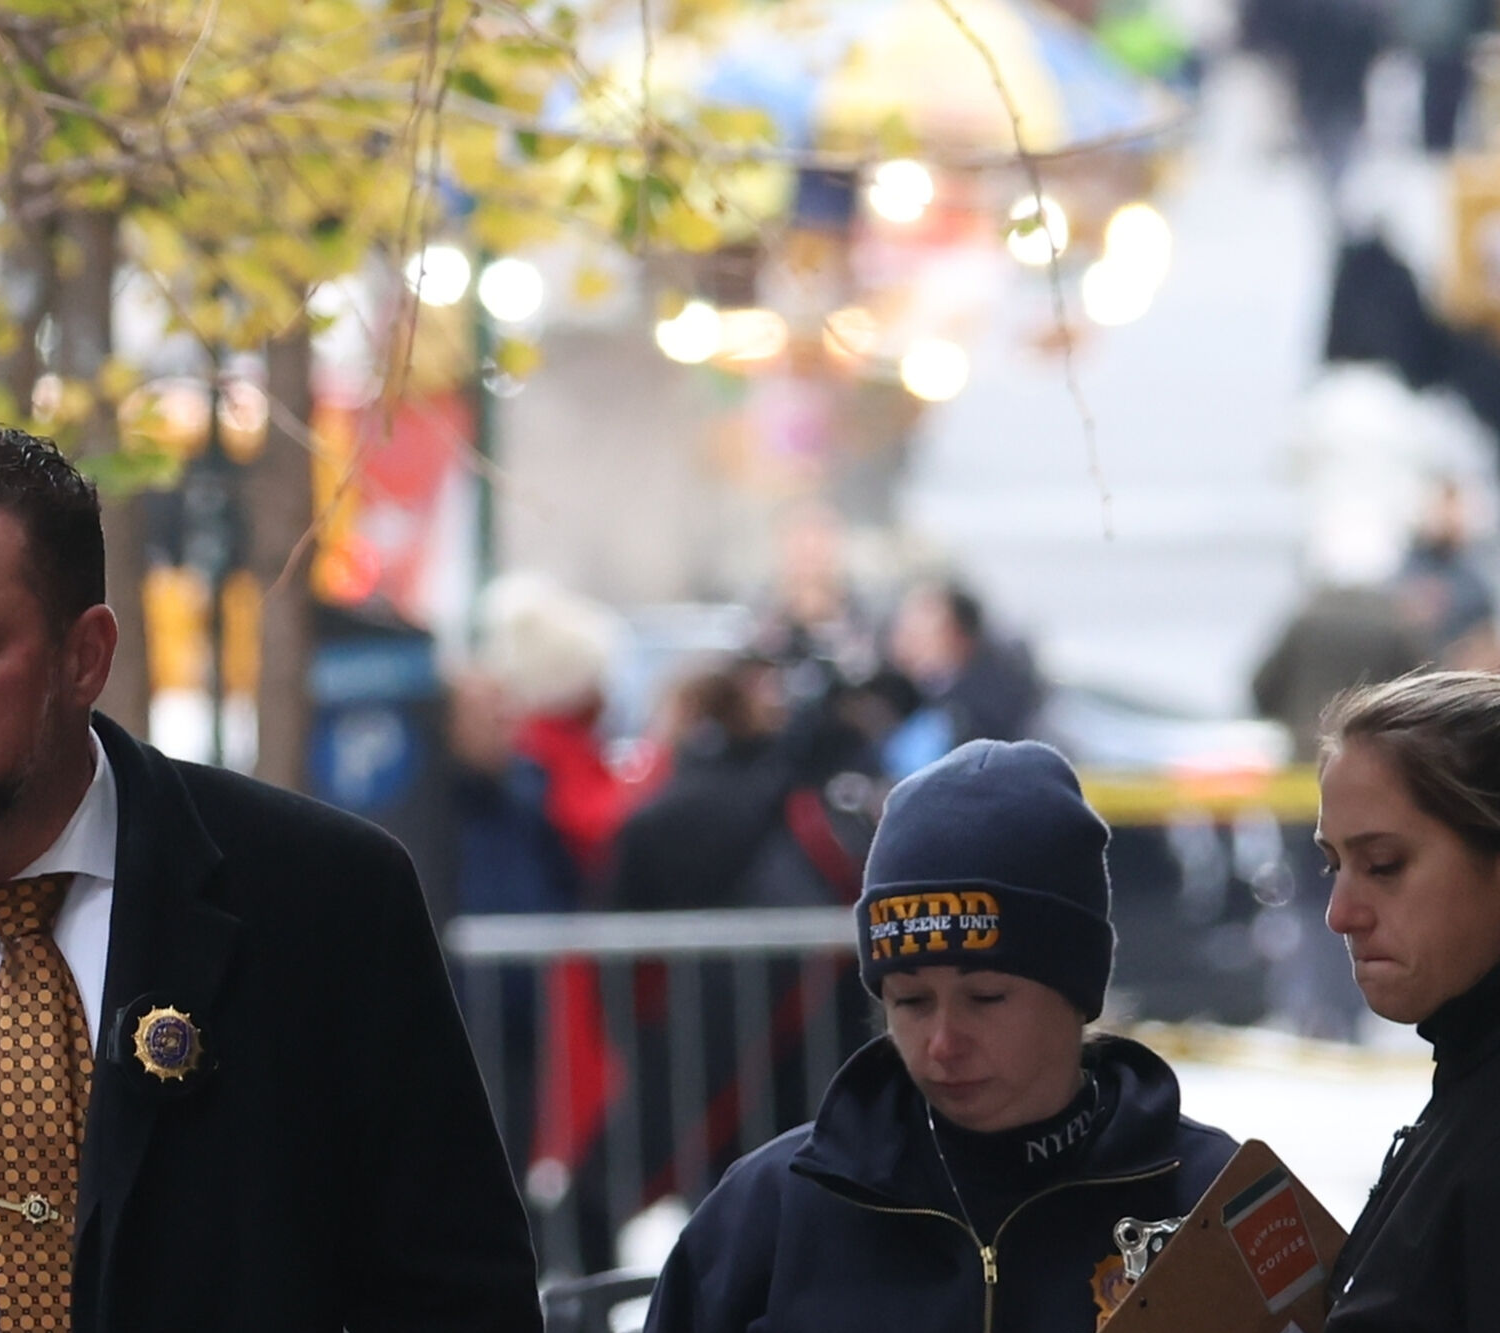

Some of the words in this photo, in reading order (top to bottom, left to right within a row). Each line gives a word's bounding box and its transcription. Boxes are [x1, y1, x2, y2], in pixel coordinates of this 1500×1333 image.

[869, 890, 1000, 960] NYPD
[902, 914, 951, 933] SCENE
[959, 914, 999, 929] UNIT
[1026, 1110, 1093, 1163] NYPD
[1249, 1217, 1297, 1257] POWERED
[1257, 1236, 1305, 1275] COFFEE
